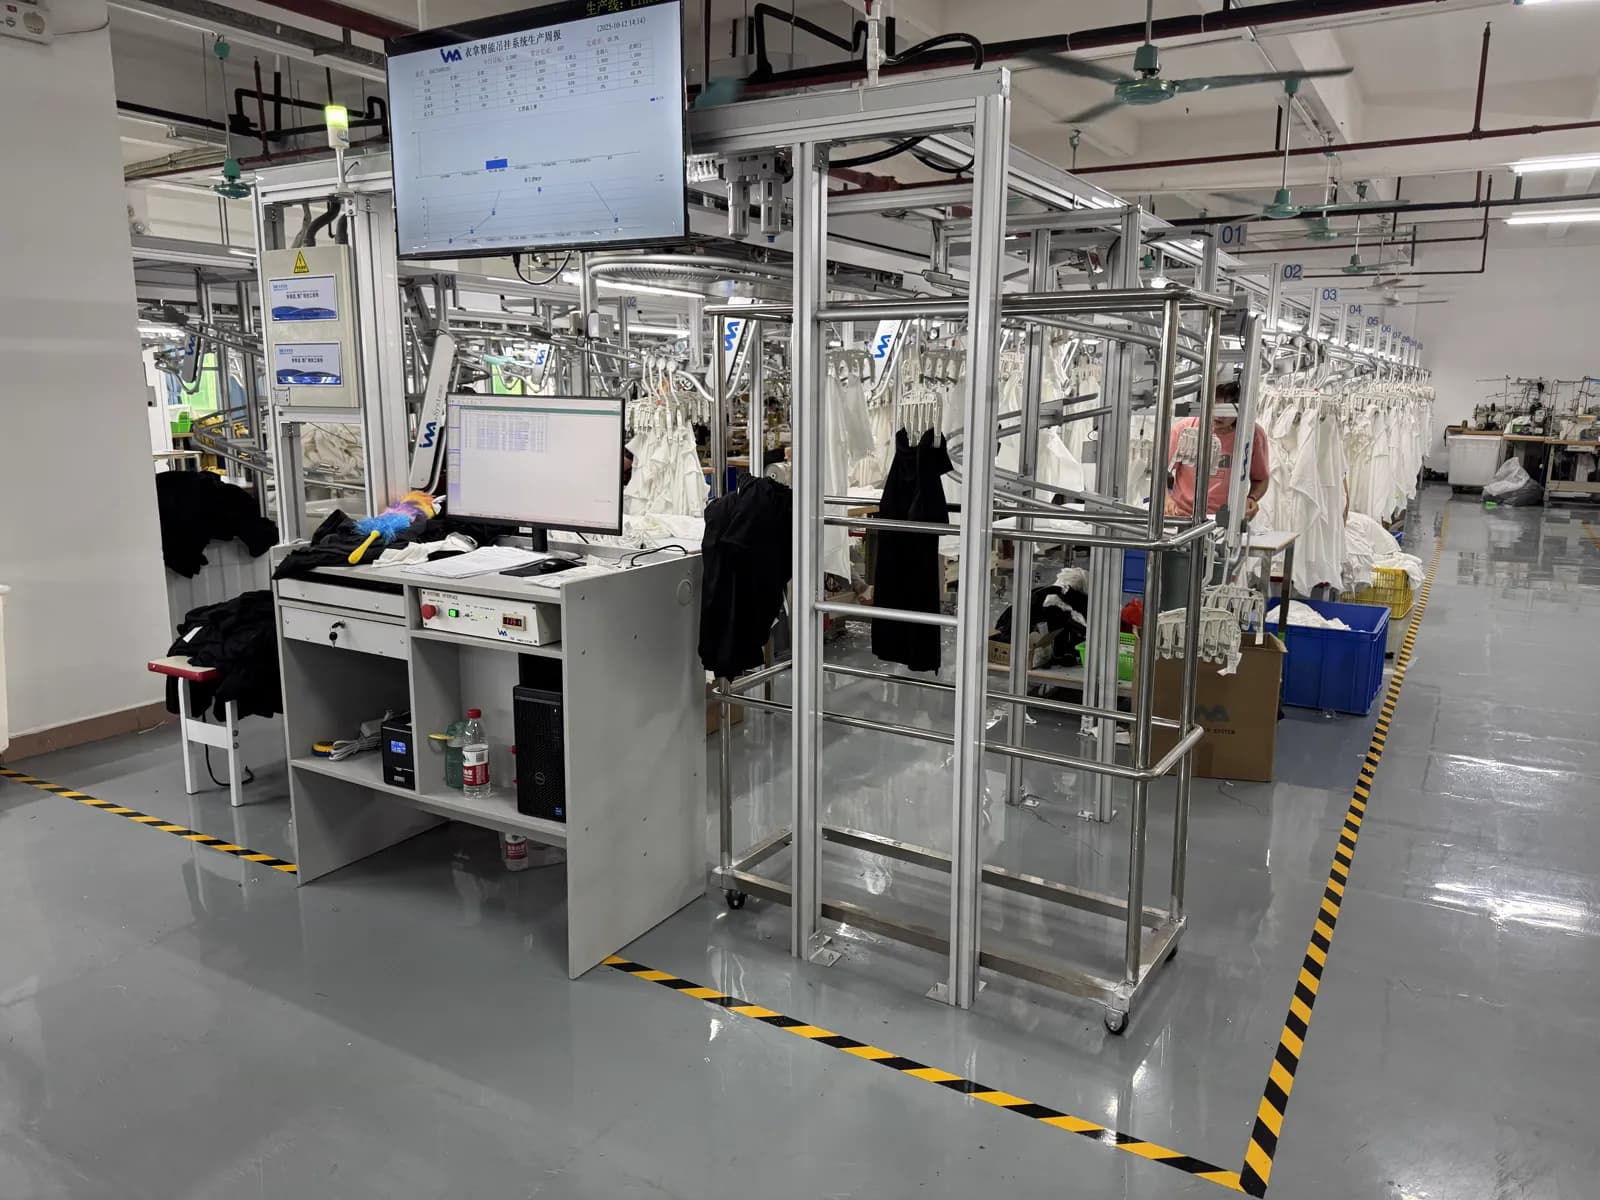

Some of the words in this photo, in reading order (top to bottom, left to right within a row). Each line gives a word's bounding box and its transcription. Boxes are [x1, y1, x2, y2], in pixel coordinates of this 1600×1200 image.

[1222, 225, 1241, 244] 01
[1283, 264, 1302, 279] 02
[1322, 288, 1337, 301] 03
[1349, 304, 1362, 315] 04
[1367, 316, 1379, 326] 05
[1381, 324, 1392, 333] 06
